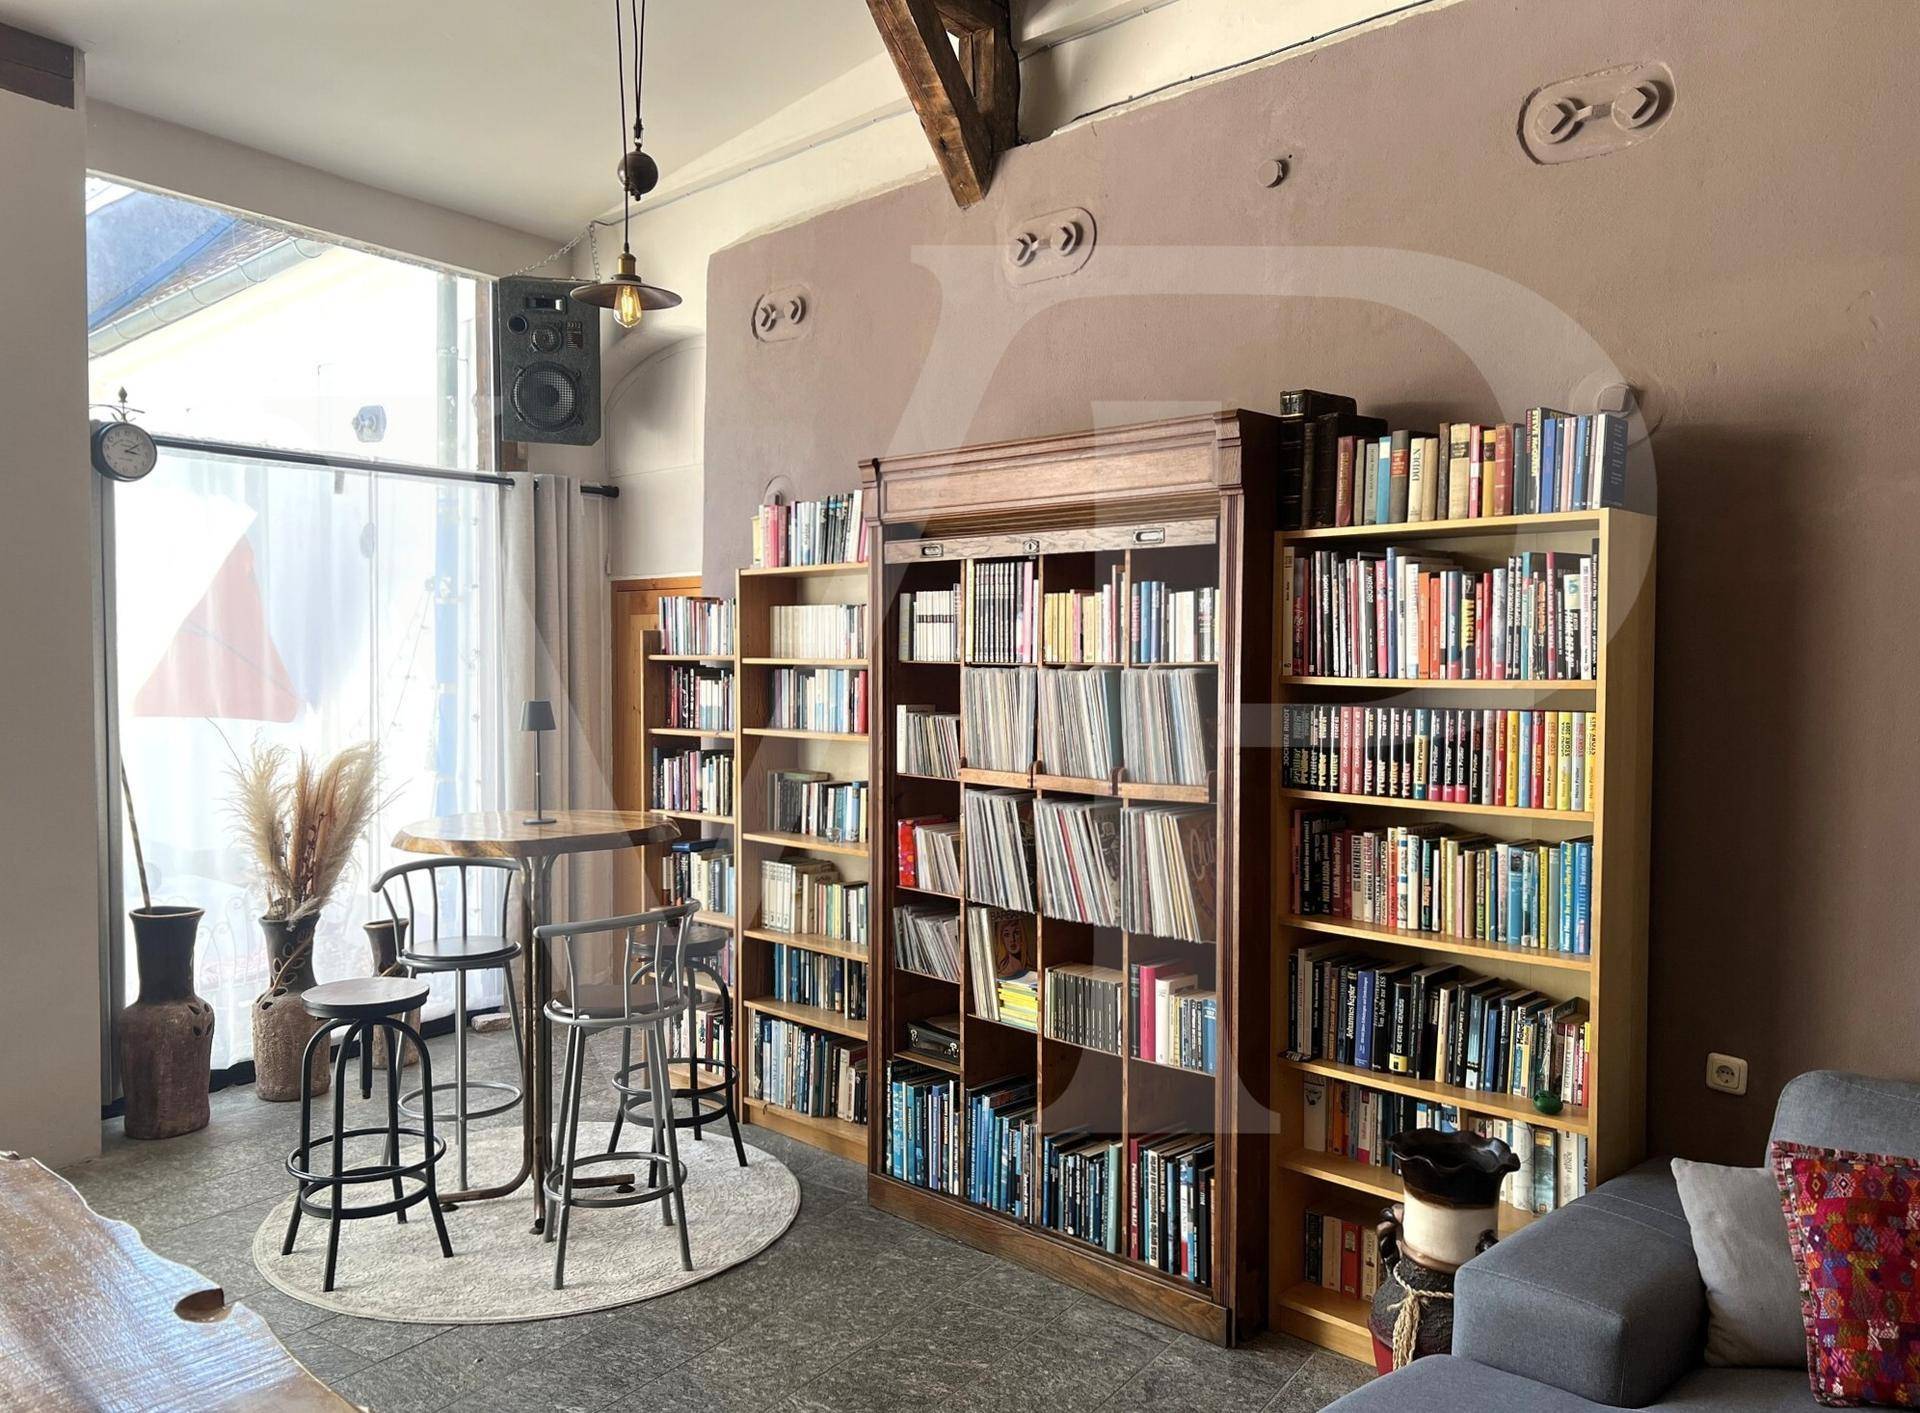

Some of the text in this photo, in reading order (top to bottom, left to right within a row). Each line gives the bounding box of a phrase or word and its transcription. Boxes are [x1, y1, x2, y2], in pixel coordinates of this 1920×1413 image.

[1412, 449, 1420, 482] DUDEN
[1322, 574, 1330, 614] Sportwagen
[1466, 599, 1475, 647] MANSELL
[1334, 836, 1343, 854] Story
[1322, 860, 1330, 885] LAUDA
[1322, 886, 1330, 902] NIKI
[1346, 984, 1356, 1039] Johannes Kepler
[1516, 1008, 1526, 1045] Malediven
